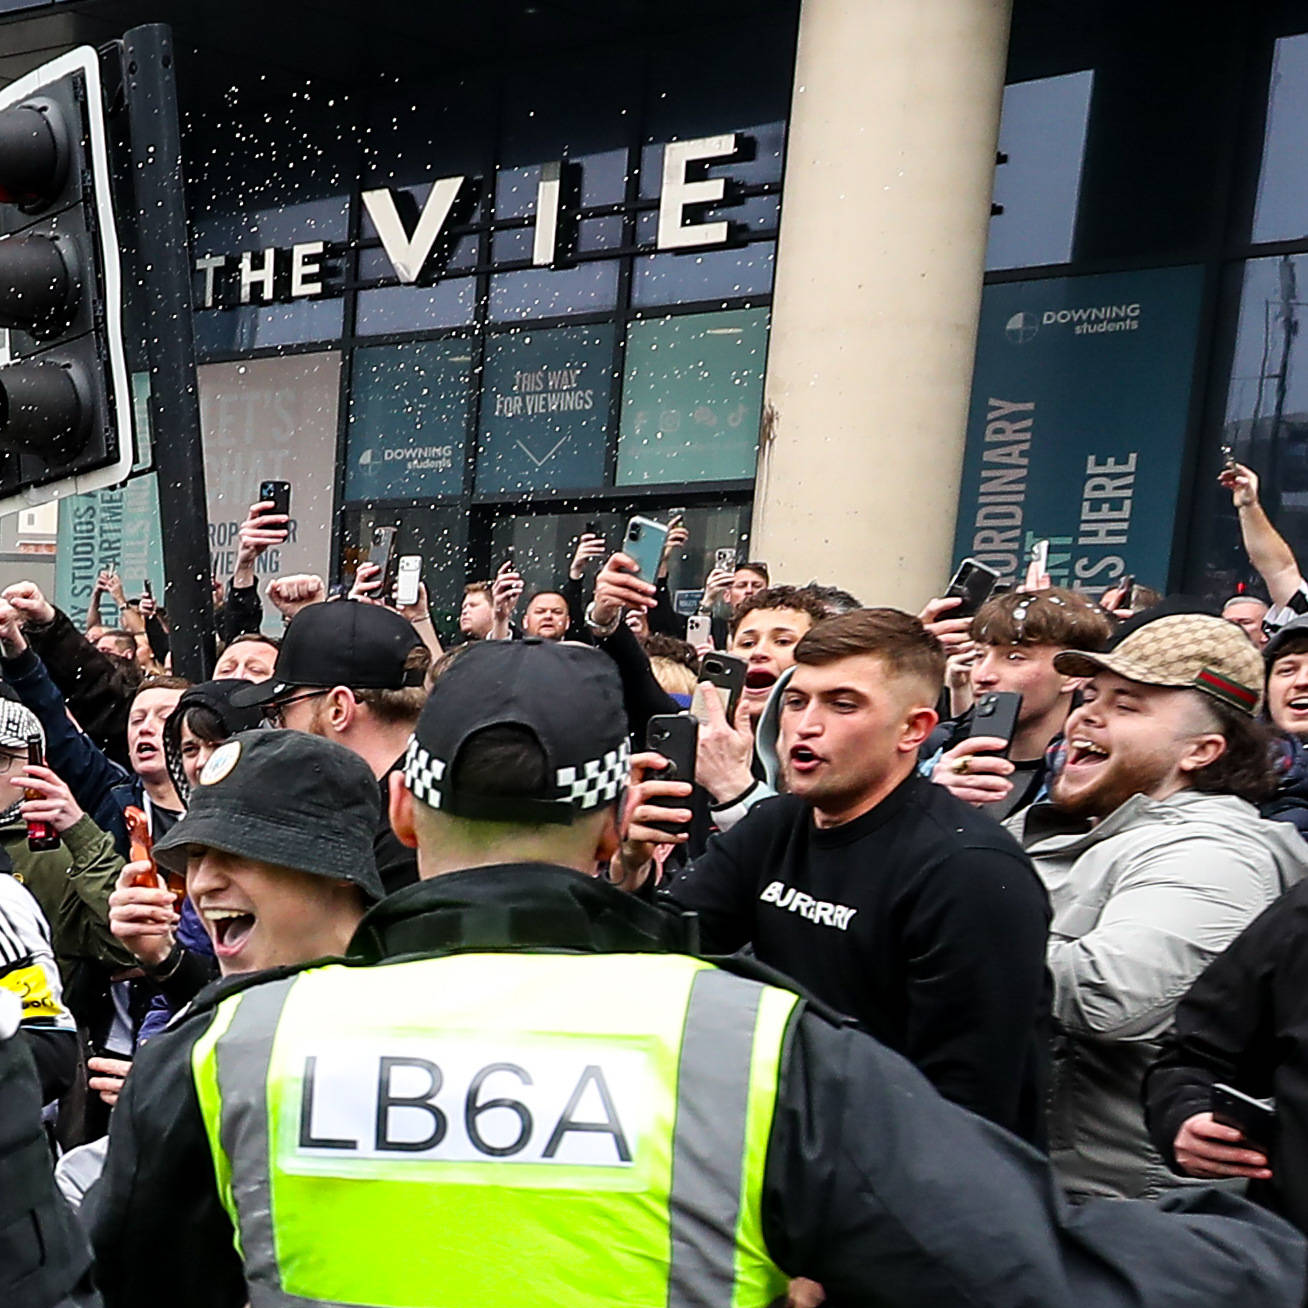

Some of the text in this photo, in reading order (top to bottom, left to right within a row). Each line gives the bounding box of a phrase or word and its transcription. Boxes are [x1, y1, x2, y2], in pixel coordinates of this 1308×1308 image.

[195, 132, 738, 308] THE VIE
[1041, 303, 1142, 325] DOWNING
[1074, 317, 1140, 335] students
[514, 368, 579, 393] THIS WAY
[495, 389, 594, 417] FOR VIEWINGS
[384, 445, 453, 462] DOWNING
[406, 455, 452, 471] students
[1077, 452, 1138, 545] HERE
[71, 505, 97, 598] STUDIOS
[298, 1055, 634, 1162] LB6A
